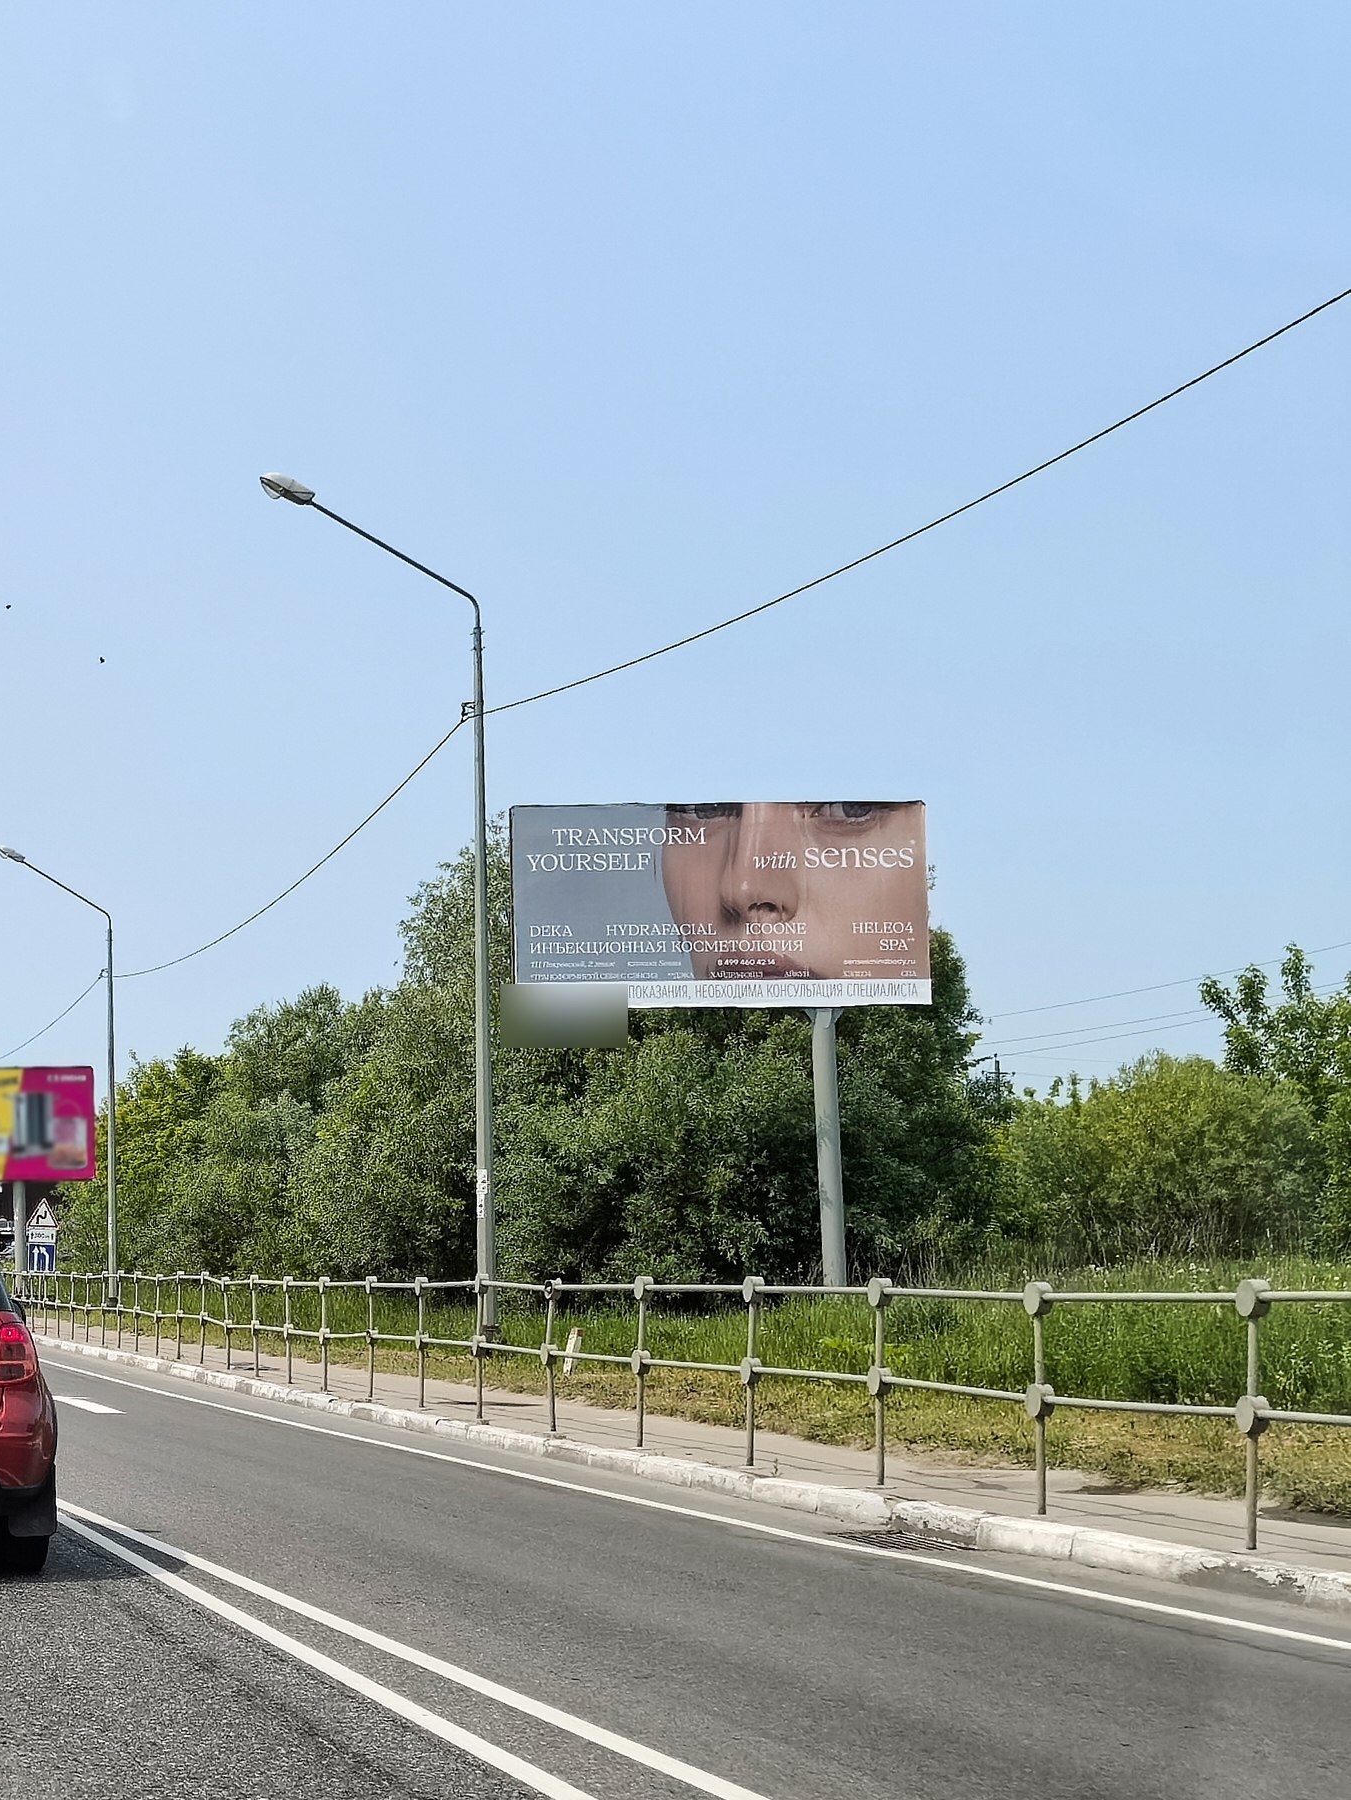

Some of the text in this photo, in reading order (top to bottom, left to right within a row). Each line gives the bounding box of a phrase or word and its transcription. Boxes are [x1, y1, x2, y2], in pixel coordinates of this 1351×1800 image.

[552, 827, 706, 846] TRANSFORM
[526, 853, 650, 872] YOURSELF
[752, 852, 797, 869] with
[529, 925, 573, 937] DEKA
[606, 923, 716, 937] HYDRAFACIAL
[745, 922, 807, 935] ICOONE
[529, 939, 803, 956] ИНЪЕКЦИОННАЯ КОСМЕТОЛОГИЯ
[695, 984, 763, 999] НЕОБХОДИМА
[766, 983, 842, 998] КОНСУЛЬТАЦИЯ
[847, 982, 918, 998] СПЕЦИАЛИСТА
